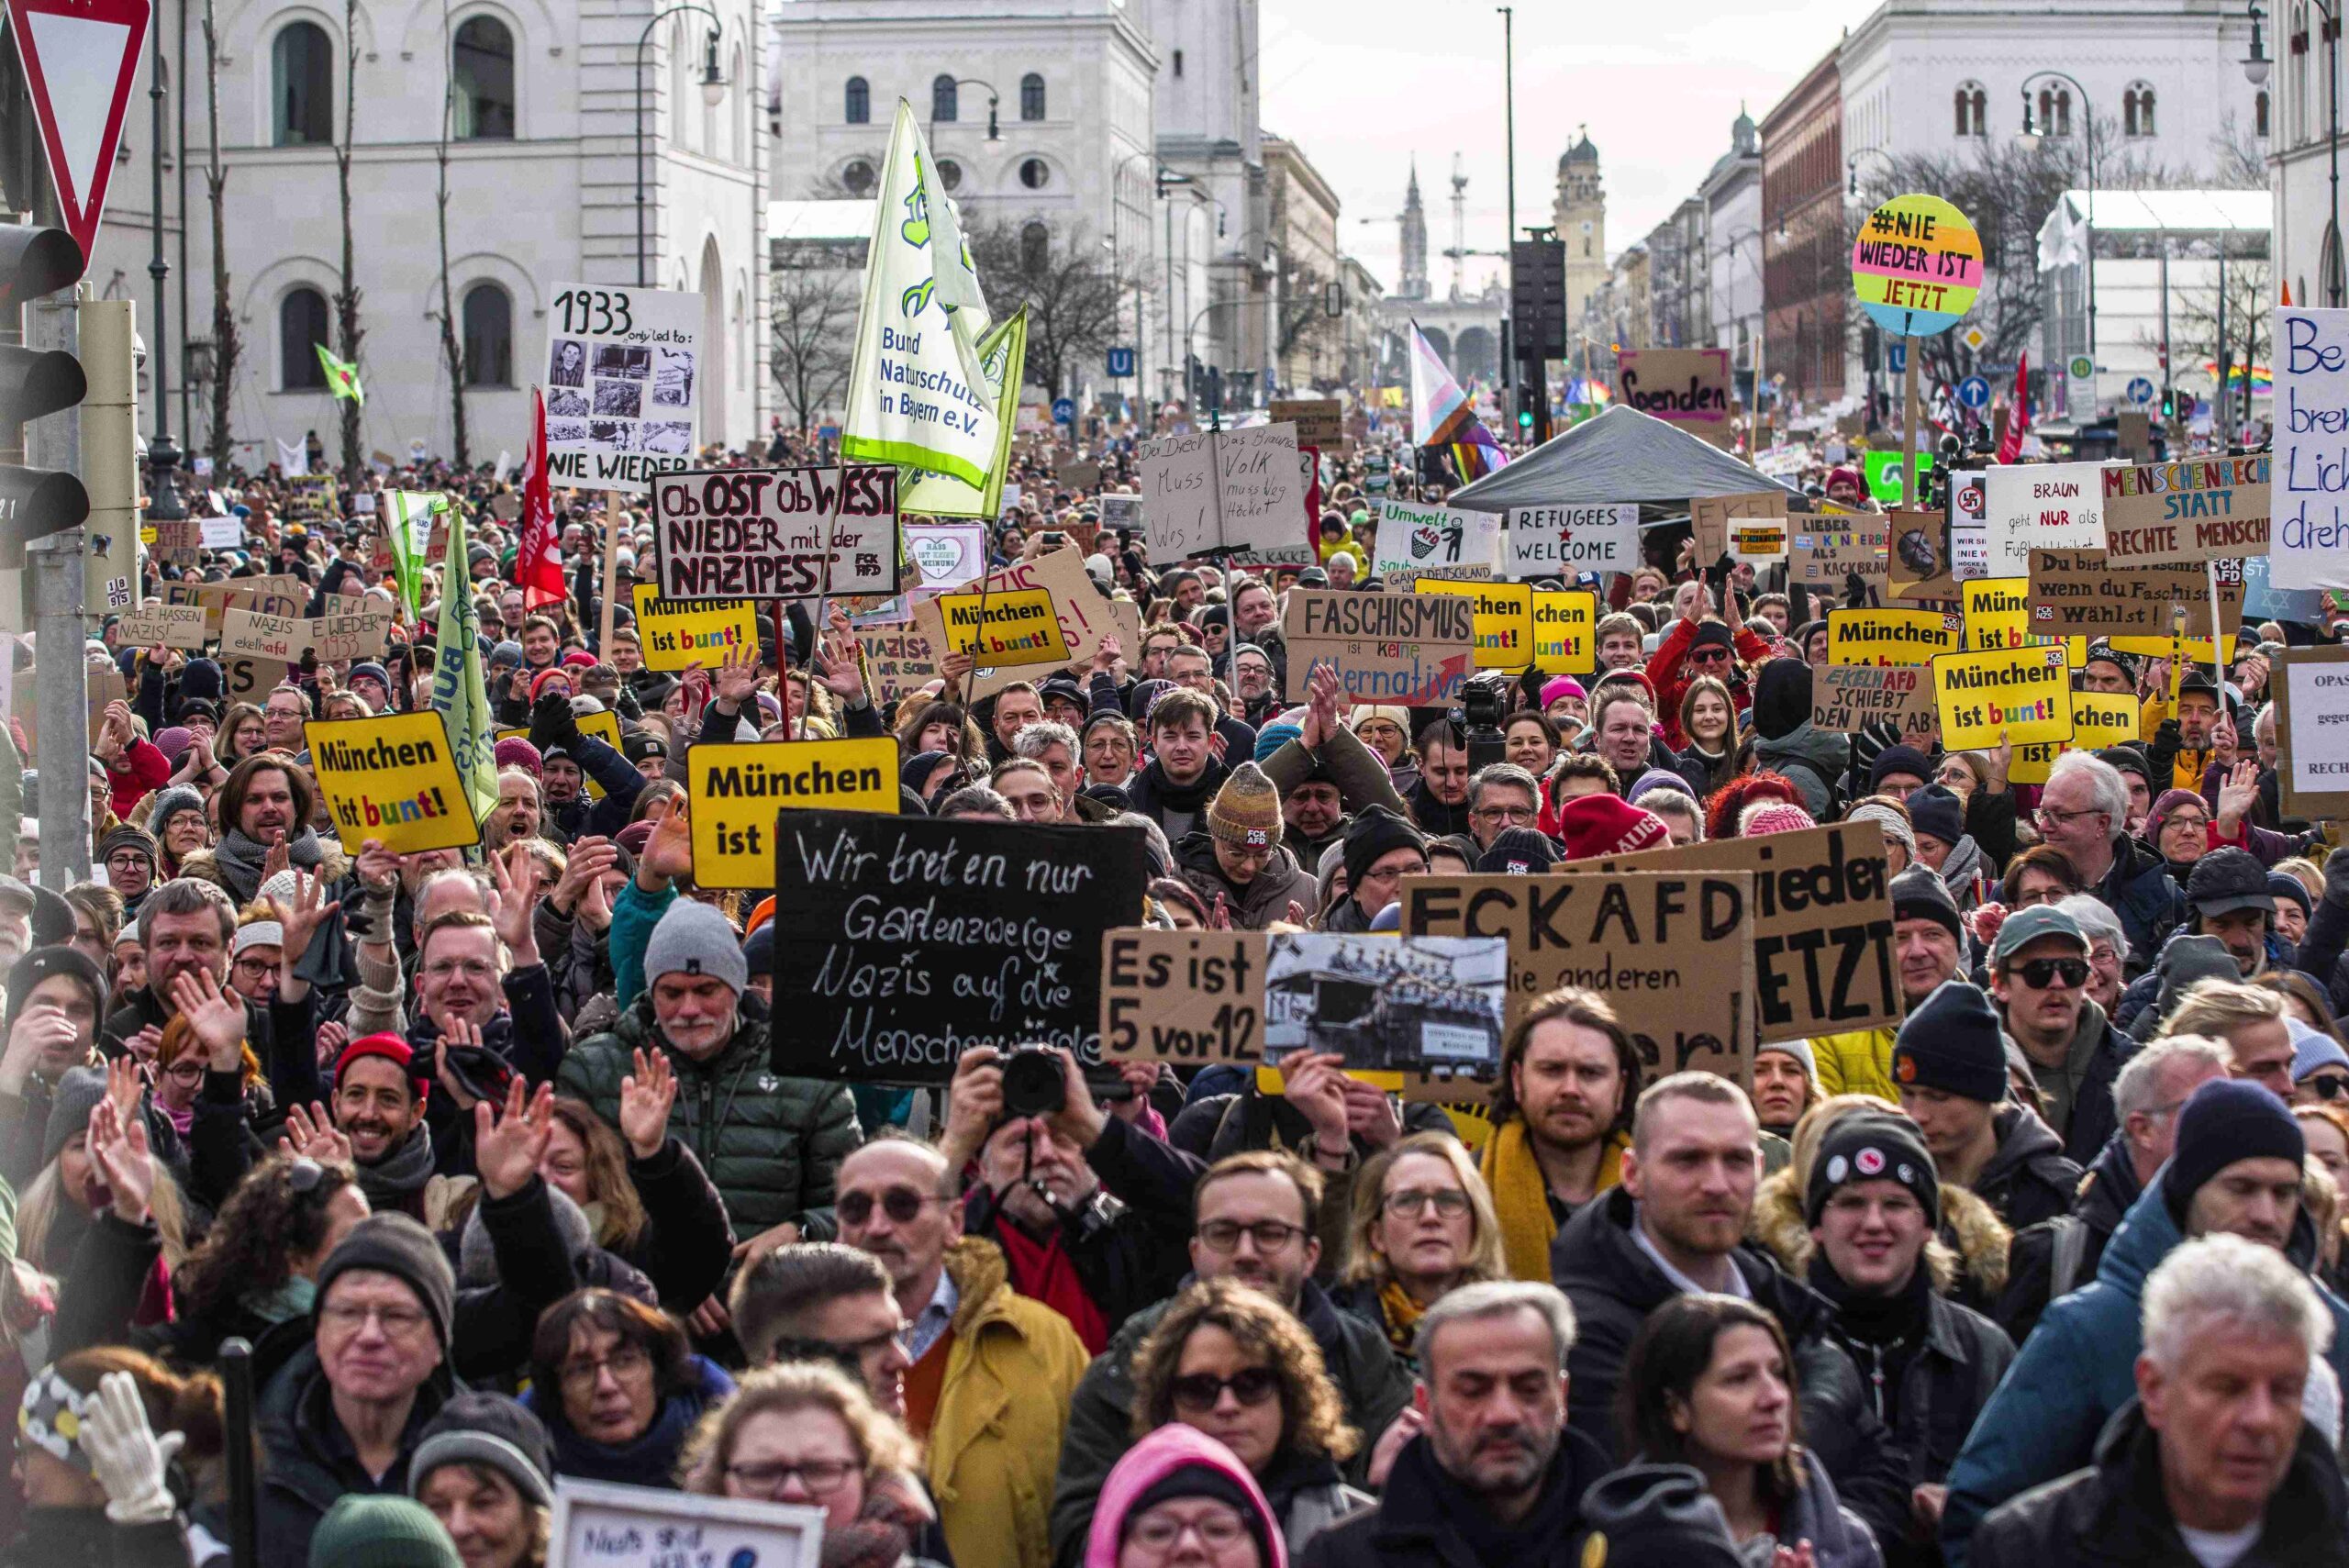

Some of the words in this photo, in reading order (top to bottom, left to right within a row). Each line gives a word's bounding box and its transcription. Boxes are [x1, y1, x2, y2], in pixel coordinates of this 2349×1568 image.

[1871, 209, 1936, 241] #NIE
[1860, 239, 1928, 272] WIEDER
[1937, 250, 1972, 279] IST
[1882, 279, 1947, 312] JETZT
[553, 290, 632, 336] 1933
[652, 329, 670, 343] led
[882, 327, 921, 355] Bund
[1113, 351, 1128, 370] U
[880, 357, 984, 413] Naturschutz
[1621, 370, 1726, 413] Spenden
[879, 389, 893, 413] in
[899, 393, 939, 425] Bayern
[943, 409, 979, 439] e.V.
[1219, 434, 1245, 450] Das
[547, 452, 588, 479] NIE
[2105, 457, 2272, 498] MENSCHENRECH
[662, 484, 701, 517] Ob
[702, 474, 774, 517] OST
[776, 479, 813, 515] Ob
[808, 467, 895, 517] WEST
[1157, 467, 1204, 496] Muss
[1226, 482, 1260, 496] muss
[2033, 482, 2079, 499] BRAUN
[1386, 504, 1448, 528] Umwelt
[2164, 489, 2232, 520] STATT
[1520, 508, 1618, 530] REFUGEES
[1802, 518, 1852, 532] LIEBER
[2009, 514, 2032, 535] geht
[2040, 509, 2070, 526] NUR
[2078, 509, 2098, 525] als
[668, 517, 786, 555] NIEDER
[791, 525, 823, 550] mit
[831, 525, 863, 549] der
[2108, 525, 2178, 557] RECHTE
[855, 552, 878, 564] FCK
[1265, 550, 1310, 564] KACKE
[1516, 541, 1617, 562] WELCOME
[1811, 548, 1837, 559] ALS
[2041, 552, 2069, 572] Du
[2075, 552, 2108, 572] bist
[2214, 558, 2241, 570] FCK
[670, 552, 841, 596] NAZIPEST
[855, 563, 881, 576] AFD
[1427, 566, 1491, 580] DEUTSCHLAND
[2037, 583, 2093, 597] wenn
[2099, 579, 2127, 597] du
[2128, 582, 2236, 602] Faschistn
[159, 607, 202, 622] HASSEN
[249, 614, 294, 634] NAZIS
[328, 615, 381, 635] WIEDER
[951, 604, 1045, 626] München
[1305, 597, 1469, 640] FASCHISMUS
[1943, 616, 1959, 624] FCK
[234, 636, 287, 656] ekelhafd
[324, 634, 360, 658] 1933
[651, 630, 676, 651] ist
[680, 624, 742, 650] bunt!
[960, 639, 987, 656] ist
[990, 629, 1050, 653] bunt!
[1838, 620, 1948, 646] München
[1979, 628, 2003, 648] ist
[1347, 641, 1361, 654] ist
[1376, 640, 1420, 660] keine
[2045, 658, 2063, 666] NZS
[877, 661, 899, 676] WIR
[1824, 669, 1917, 691] EKELHAFD
[1945, 662, 2057, 690] München
[1831, 688, 1909, 709] SCHIEBT
[1814, 706, 1852, 728] DEN
[1858, 710, 1902, 731] MIST
[1905, 711, 1931, 734] AB
[1954, 705, 1983, 728] ist
[1988, 697, 2055, 725] bunt!
[318, 736, 436, 773] München
[706, 760, 882, 798] München
[333, 794, 362, 827] ist
[363, 786, 449, 828] bunt!
[717, 823, 762, 855] ist
[1247, 829, 1266, 838] FCK
[796, 828, 878, 884] Wir
[887, 831, 1006, 887] treten
[1026, 860, 1094, 894] nur
[1507, 862, 1529, 872] FCK
[1410, 884, 1573, 951] FCK
[1589, 878, 1742, 944] AFD
[844, 895, 1073, 963] Gartenzwerge
[1109, 939, 1172, 988] Es
[1187, 940, 1251, 995] ist
[1557, 951, 1680, 991] anderen
[812, 943, 930, 997] Nazis
[953, 956, 1019, 1022] auf
[1020, 962, 1072, 1008] die
[1108, 998, 1139, 1052] 5
